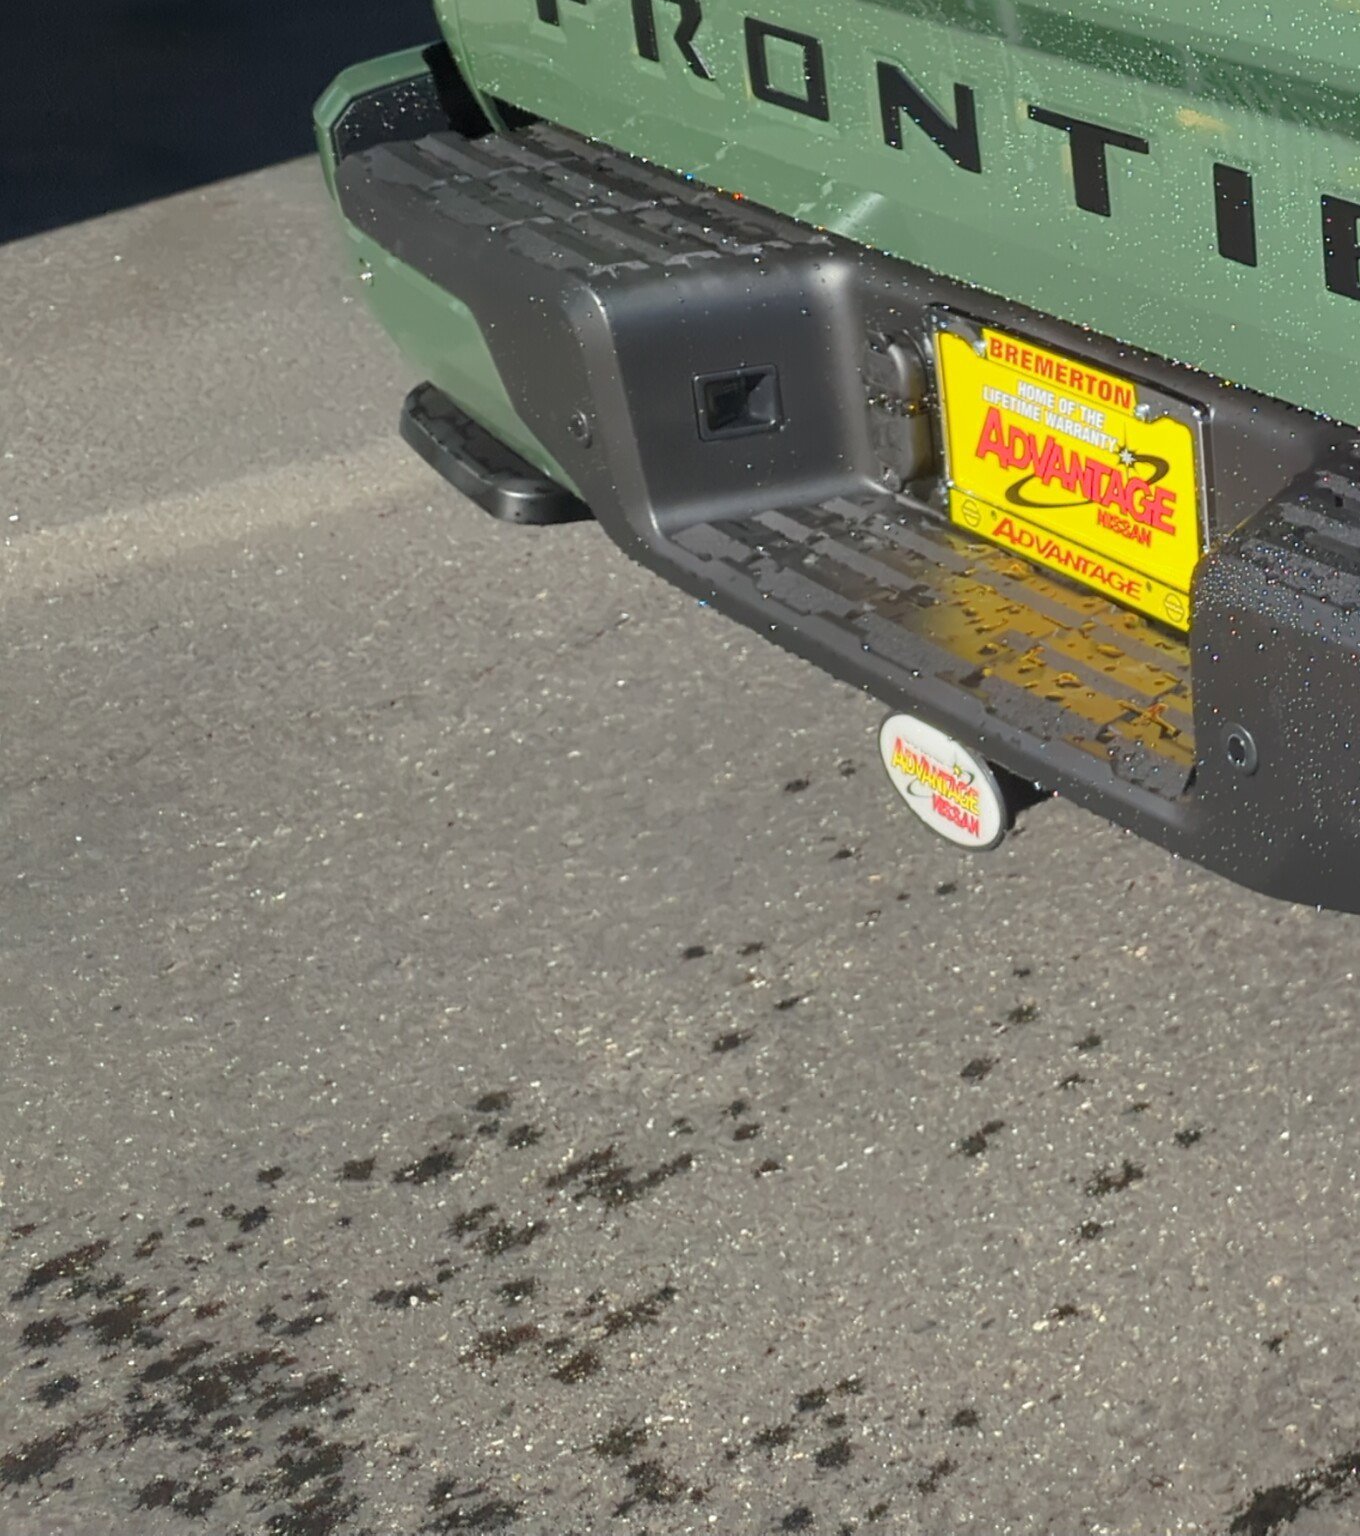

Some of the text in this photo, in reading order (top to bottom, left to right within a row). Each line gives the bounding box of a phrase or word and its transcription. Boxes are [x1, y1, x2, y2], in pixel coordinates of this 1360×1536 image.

[989, 336, 1132, 409] BREMERTON
[1017, 380, 1105, 429] HOME OF THE
[982, 385, 1119, 453] LIFETIME WARRANTY
[975, 406, 1177, 537] ADVANTAGE
[992, 517, 1142, 602] ADVANTAGE
[1097, 508, 1153, 548] NISSAN
[892, 737, 980, 816] ADVANTAGE
[932, 793, 980, 837] NISSAN
